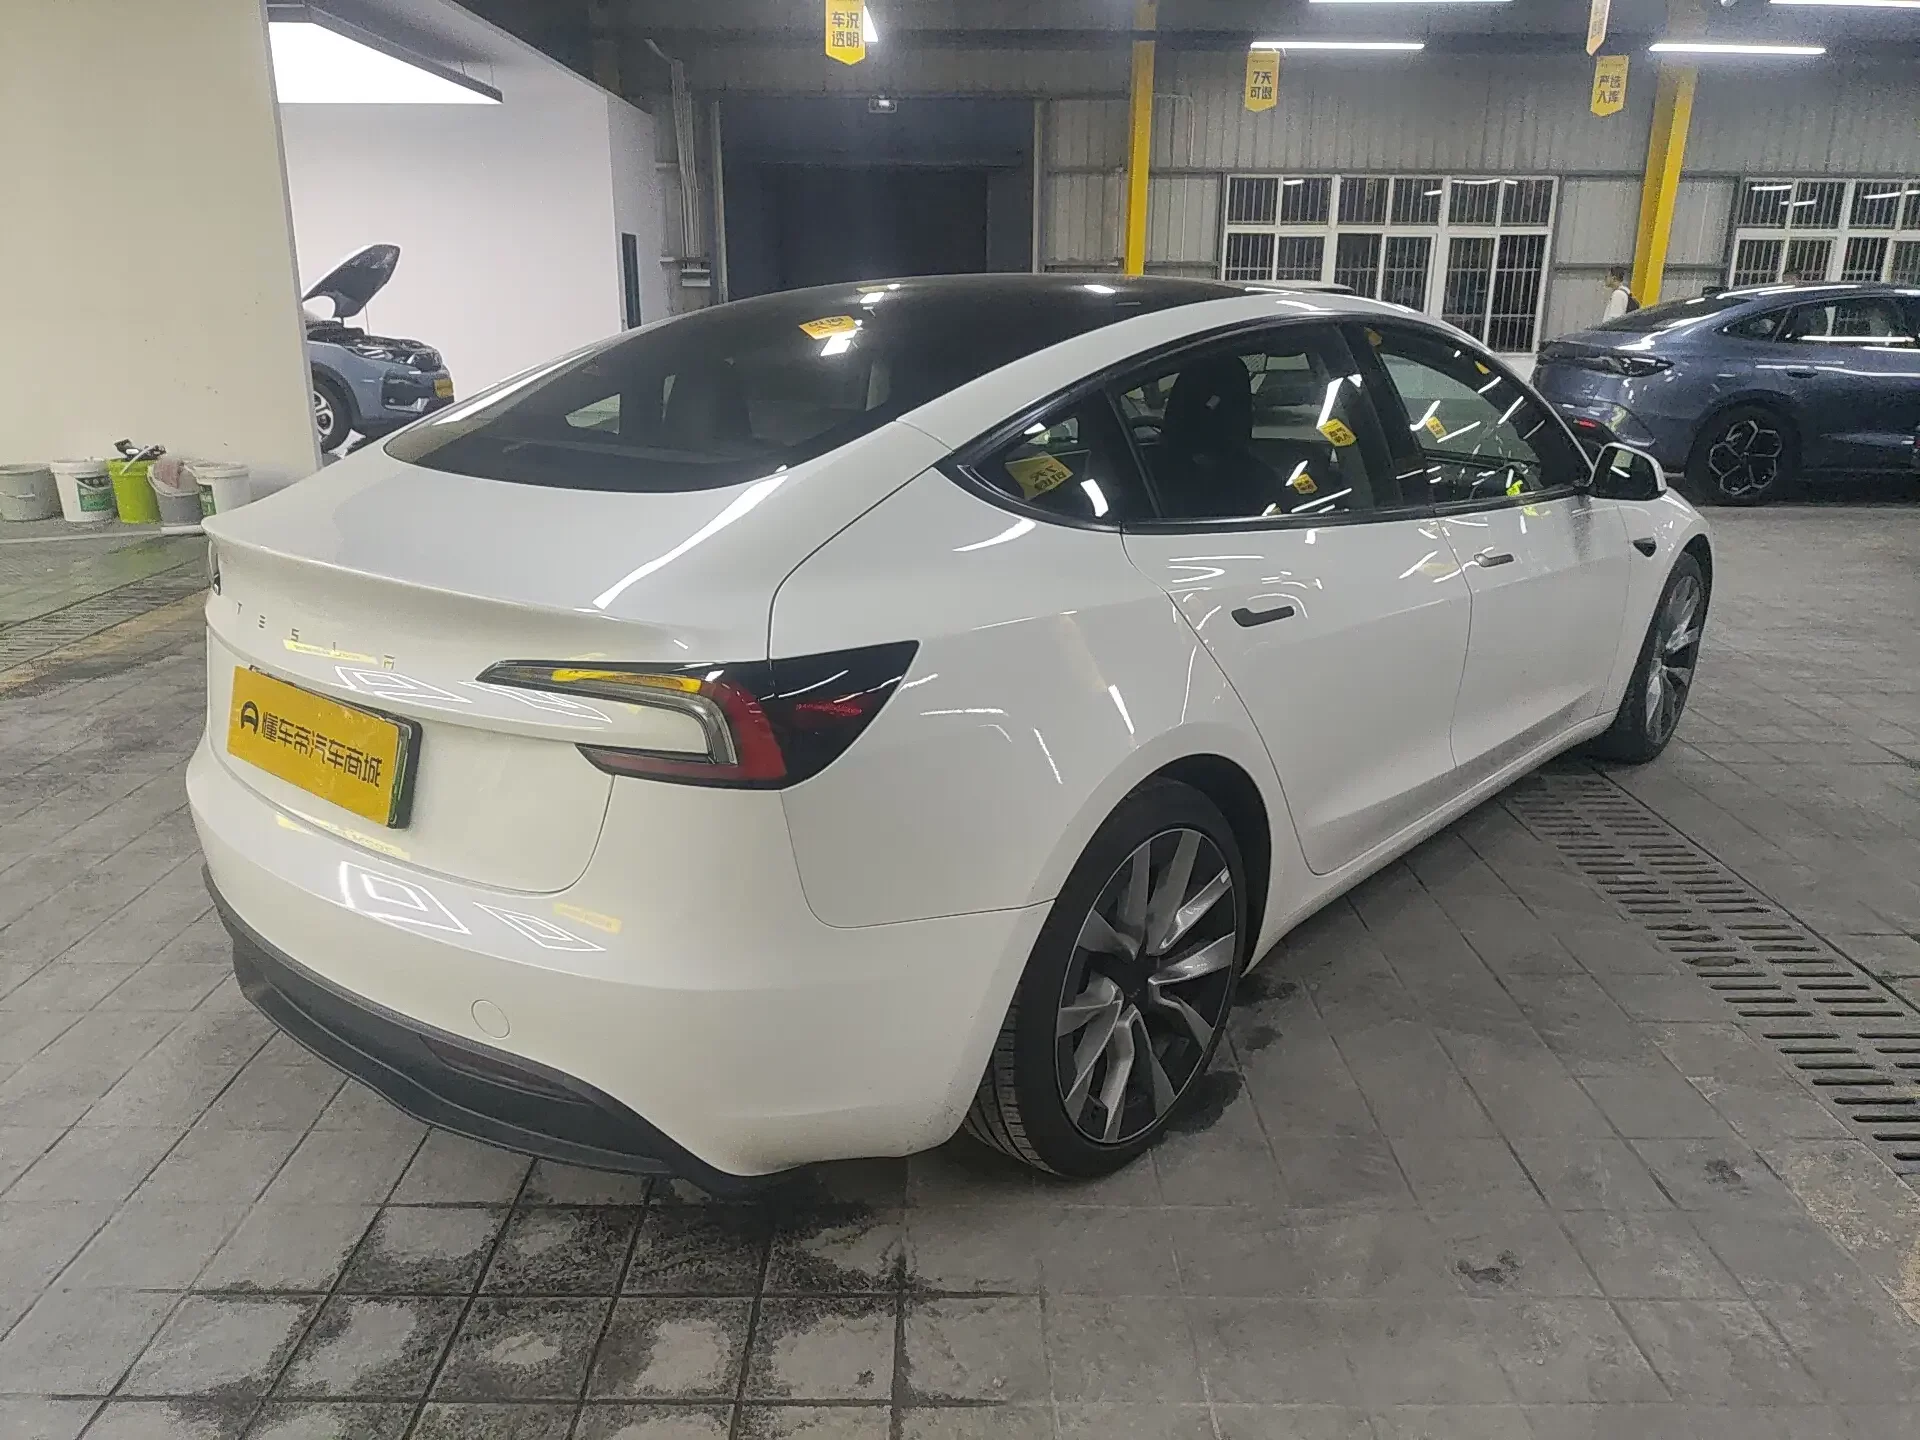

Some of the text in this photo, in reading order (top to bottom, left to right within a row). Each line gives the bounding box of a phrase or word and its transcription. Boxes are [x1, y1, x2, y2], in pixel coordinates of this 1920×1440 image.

[832, 11, 859, 28] 车况
[832, 31, 860, 48] 透明
[1253, 71, 1272, 84] 7天
[262, 712, 382, 787] 懂车帝汽车商城
